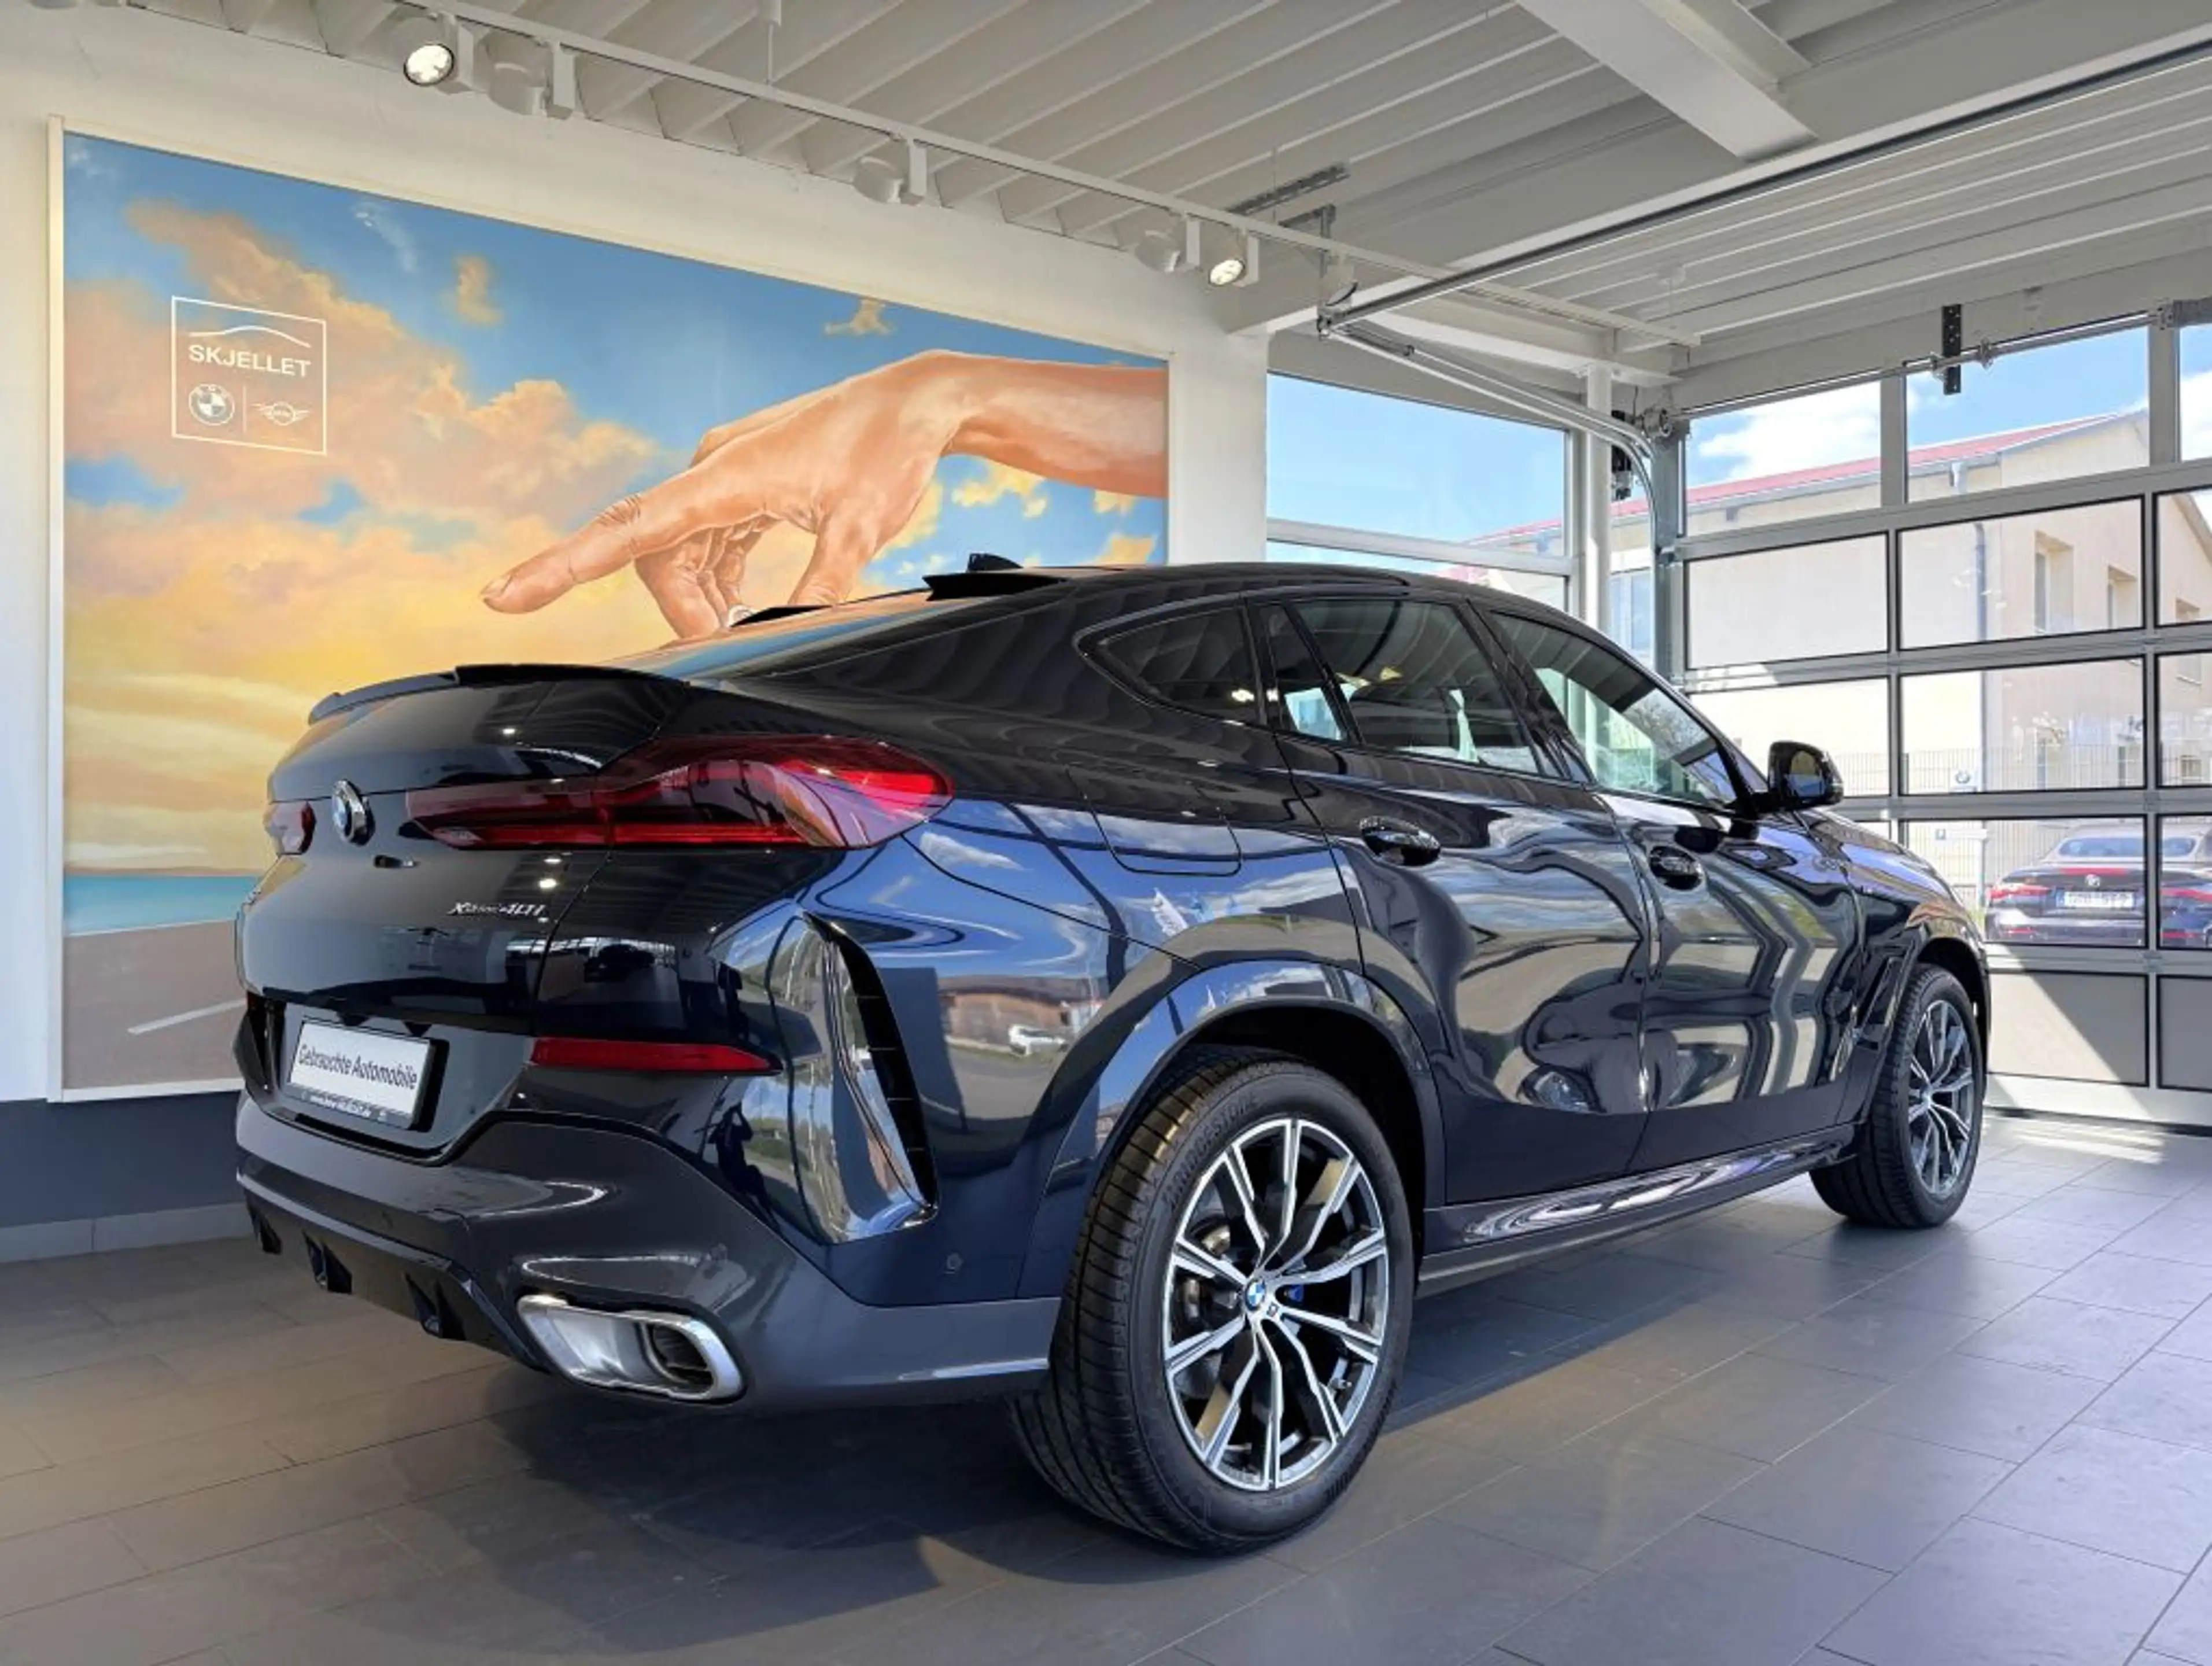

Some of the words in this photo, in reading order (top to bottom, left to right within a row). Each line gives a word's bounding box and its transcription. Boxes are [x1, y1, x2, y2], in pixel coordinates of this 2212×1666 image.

[189, 345, 311, 377] SKJELLET
[299, 1044, 350, 1075] Gebrauchte
[352, 1055, 418, 1089] Automobile
